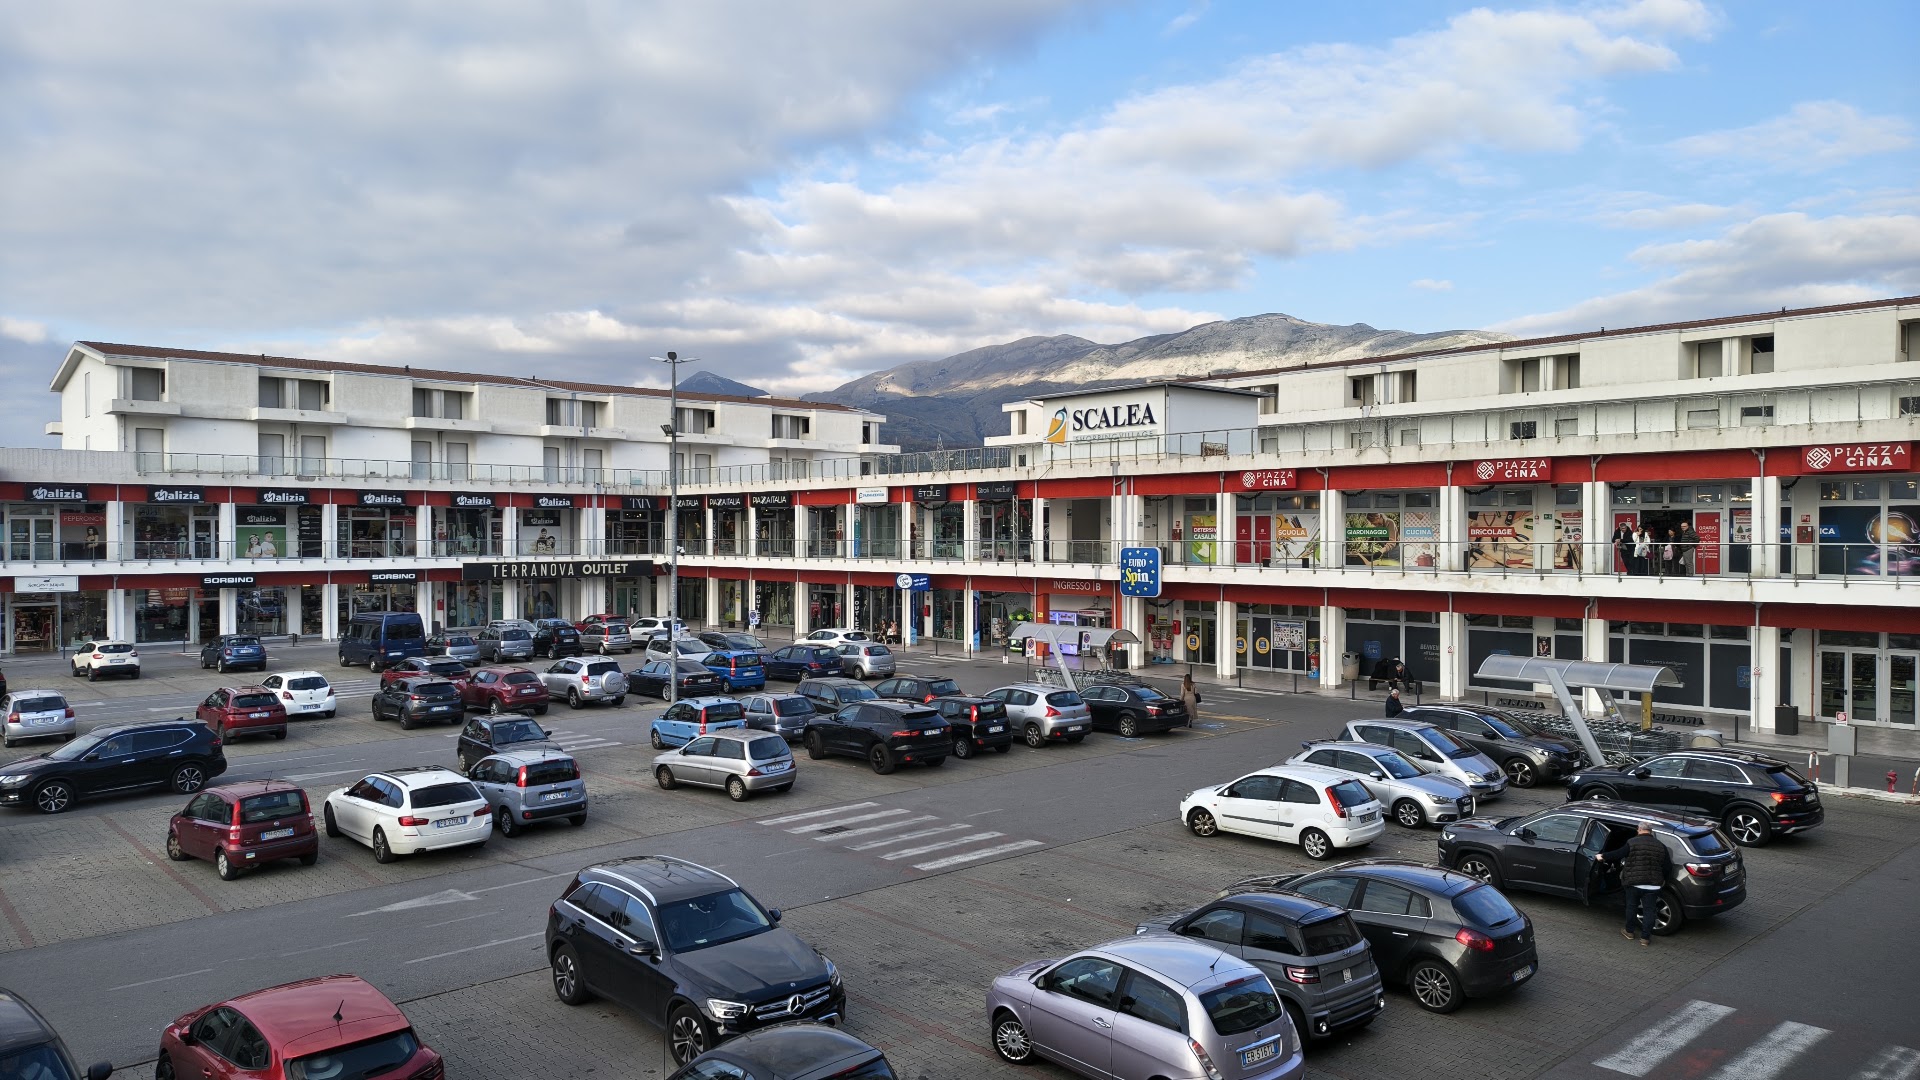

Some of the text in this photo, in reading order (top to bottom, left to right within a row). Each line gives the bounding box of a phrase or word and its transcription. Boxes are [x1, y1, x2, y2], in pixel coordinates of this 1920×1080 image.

[1072, 403, 1157, 431] SCALEA
[1119, 431, 1153, 439] VILLAGE
[32, 487, 83, 499] Malizia
[154, 489, 200, 501] Malizia
[263, 491, 305, 502] Malizia
[364, 493, 402, 504] Malizia
[457, 495, 492, 505] Malizia
[539, 496, 571, 507] Malizia
[1128, 558, 1147, 567] EURO
[492, 563, 628, 577] TERRANOVA OUTLET
[204, 576, 254, 584] SORBINO
[1125, 568, 1150, 586] Spin
[1053, 581, 1102, 591] INGRESSO B
[1246, 1044, 1275, 1063] EB 516TL
